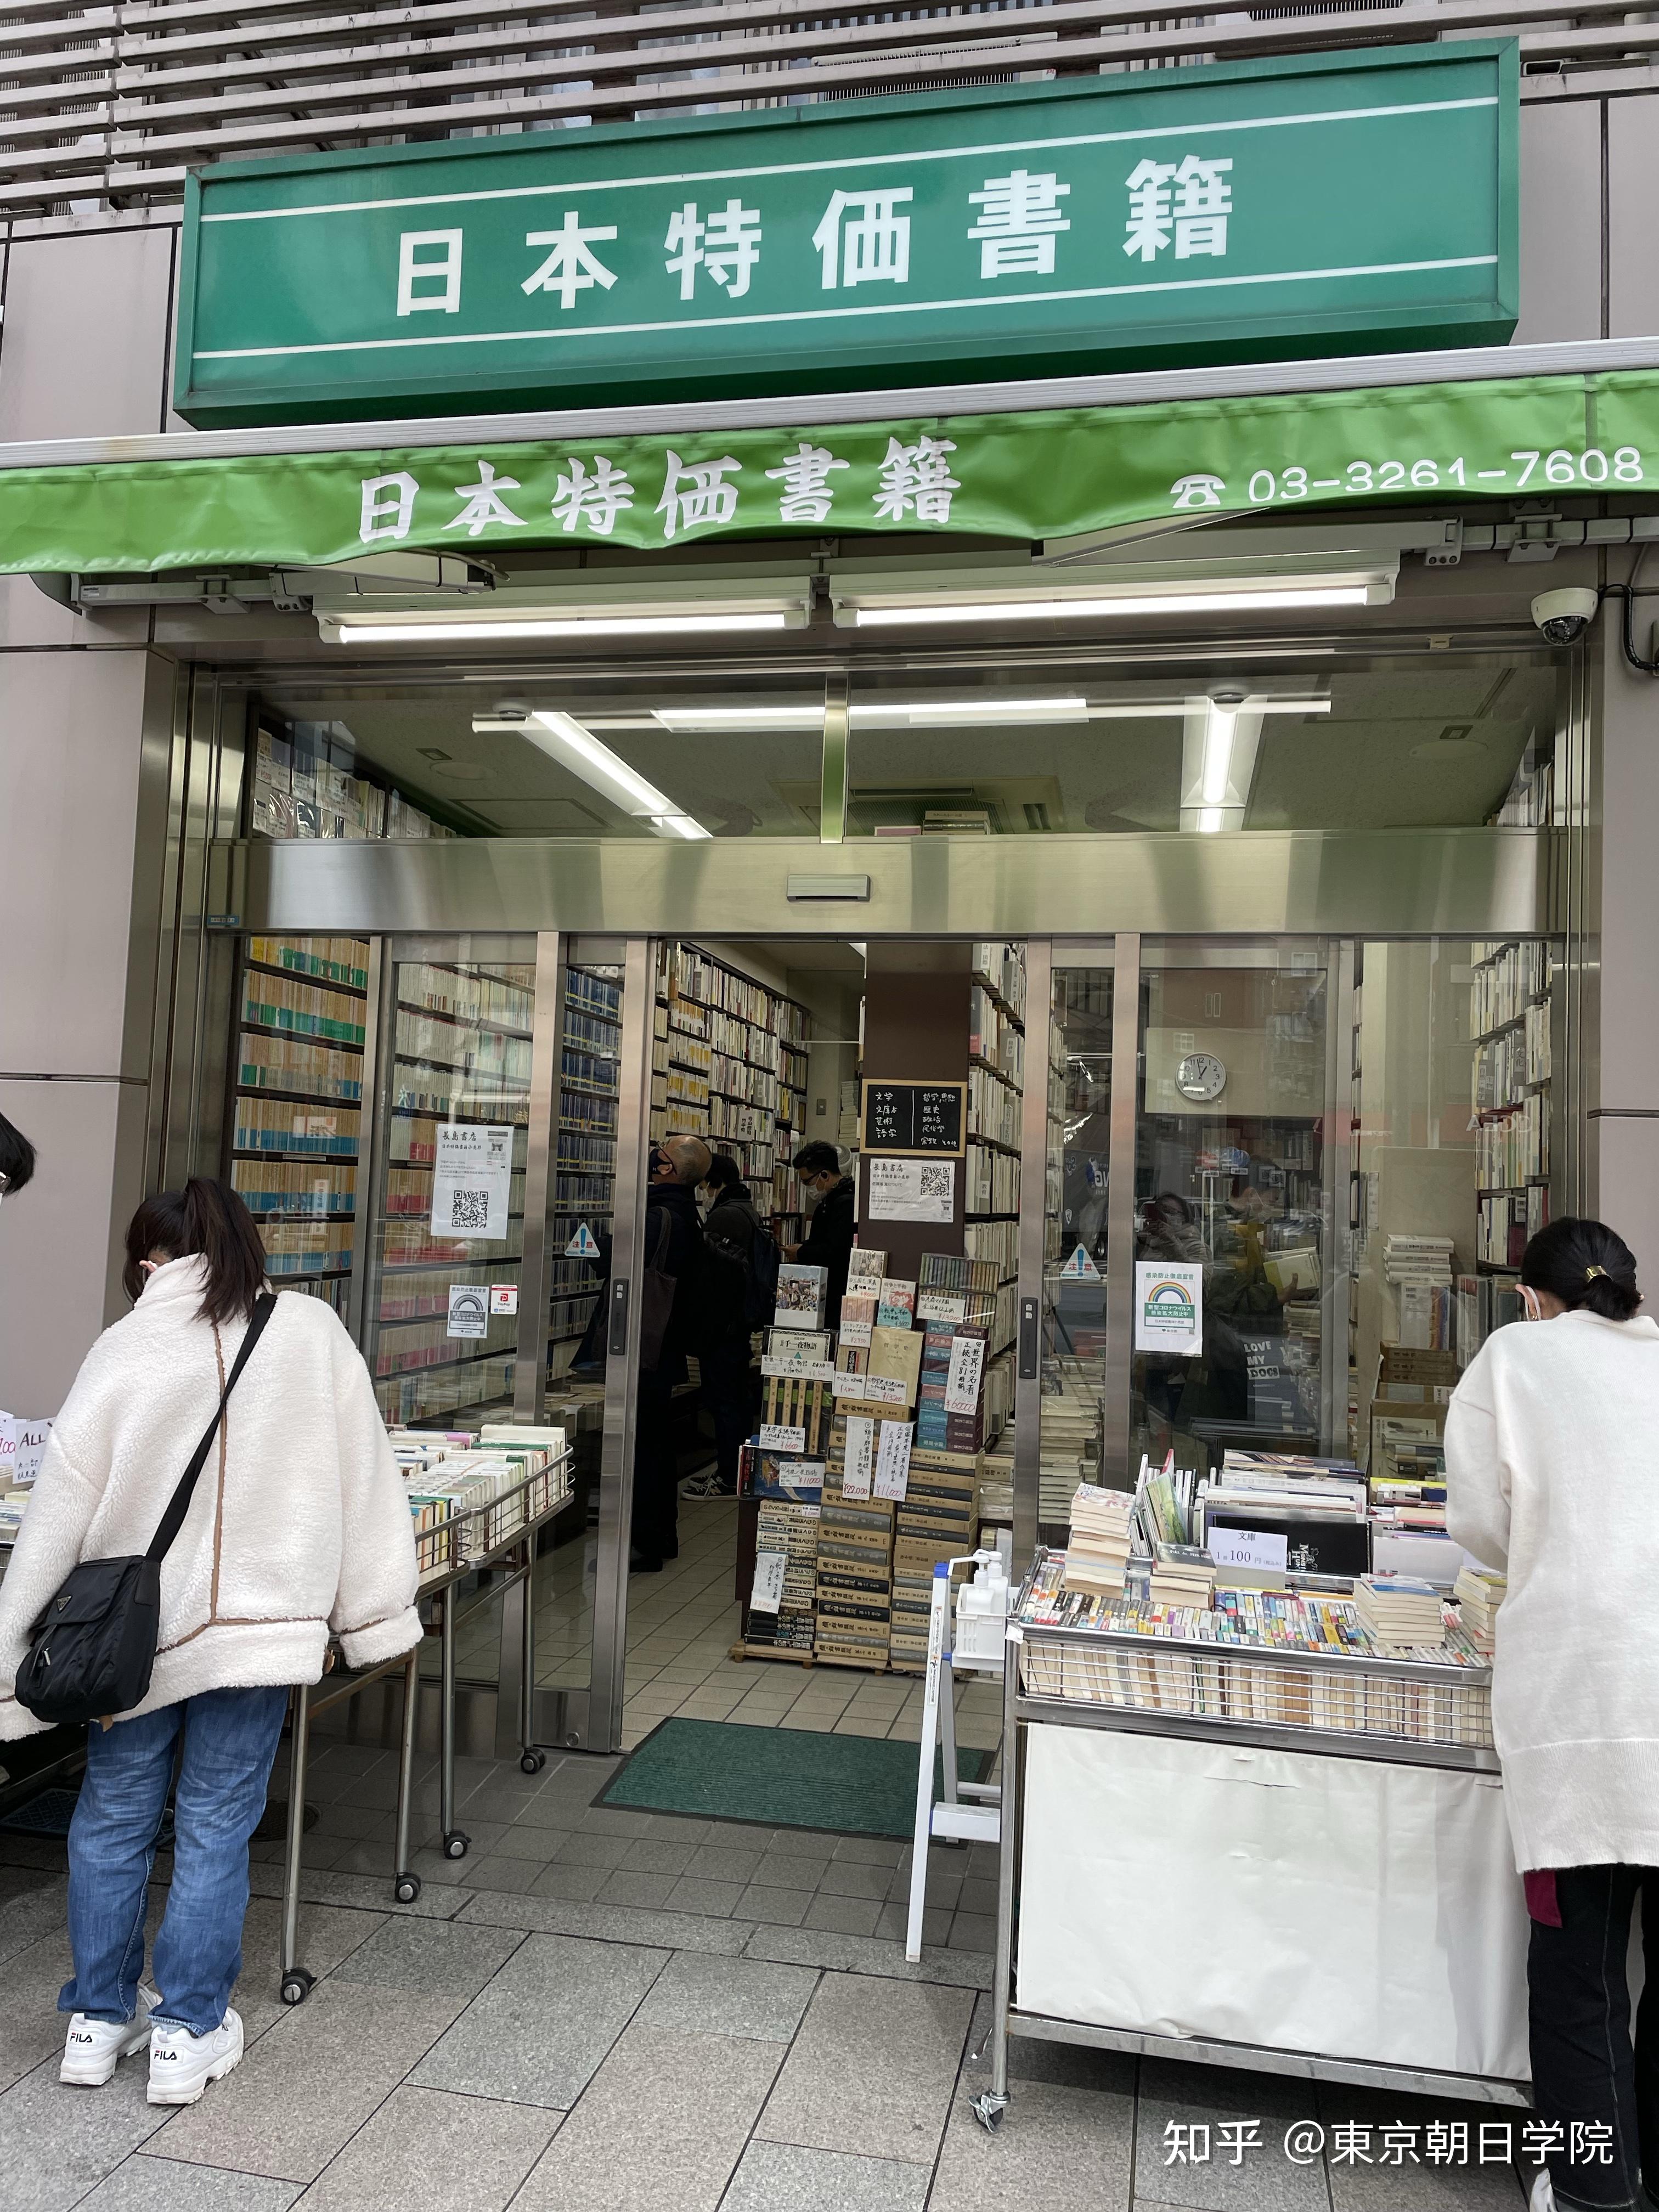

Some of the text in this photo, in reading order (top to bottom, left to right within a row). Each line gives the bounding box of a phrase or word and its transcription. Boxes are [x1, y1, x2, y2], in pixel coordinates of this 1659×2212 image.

[396, 155, 1234, 317] 日本特価書籍
[1248, 447, 1644, 503] 03-3261-7608
[359, 435, 961, 544] 日本特価書籍
[875, 1092, 893, 1101] 文学
[876, 1104, 898, 1116] 文庫本
[922, 1115, 941, 1124] 政治
[442, 1131, 477, 1141] 長島書店
[873, 1163, 905, 1172] 長島書店
[572, 1240, 593, 1249] 注意
[1069, 1262, 1092, 1271] 注意
[1244, 1341, 1272, 1353] LOVE
[1246, 1355, 1265, 1365] MY
[966, 1347, 981, 1395] 世界の名著
[19, 1432, 46, 1449] ALL
[1238, 1531, 1256, 1542] 文庫
[1231, 1550, 1251, 1562] 100
[70, 2032, 93, 2043] FILA
[154, 2050, 178, 2061] FILA
